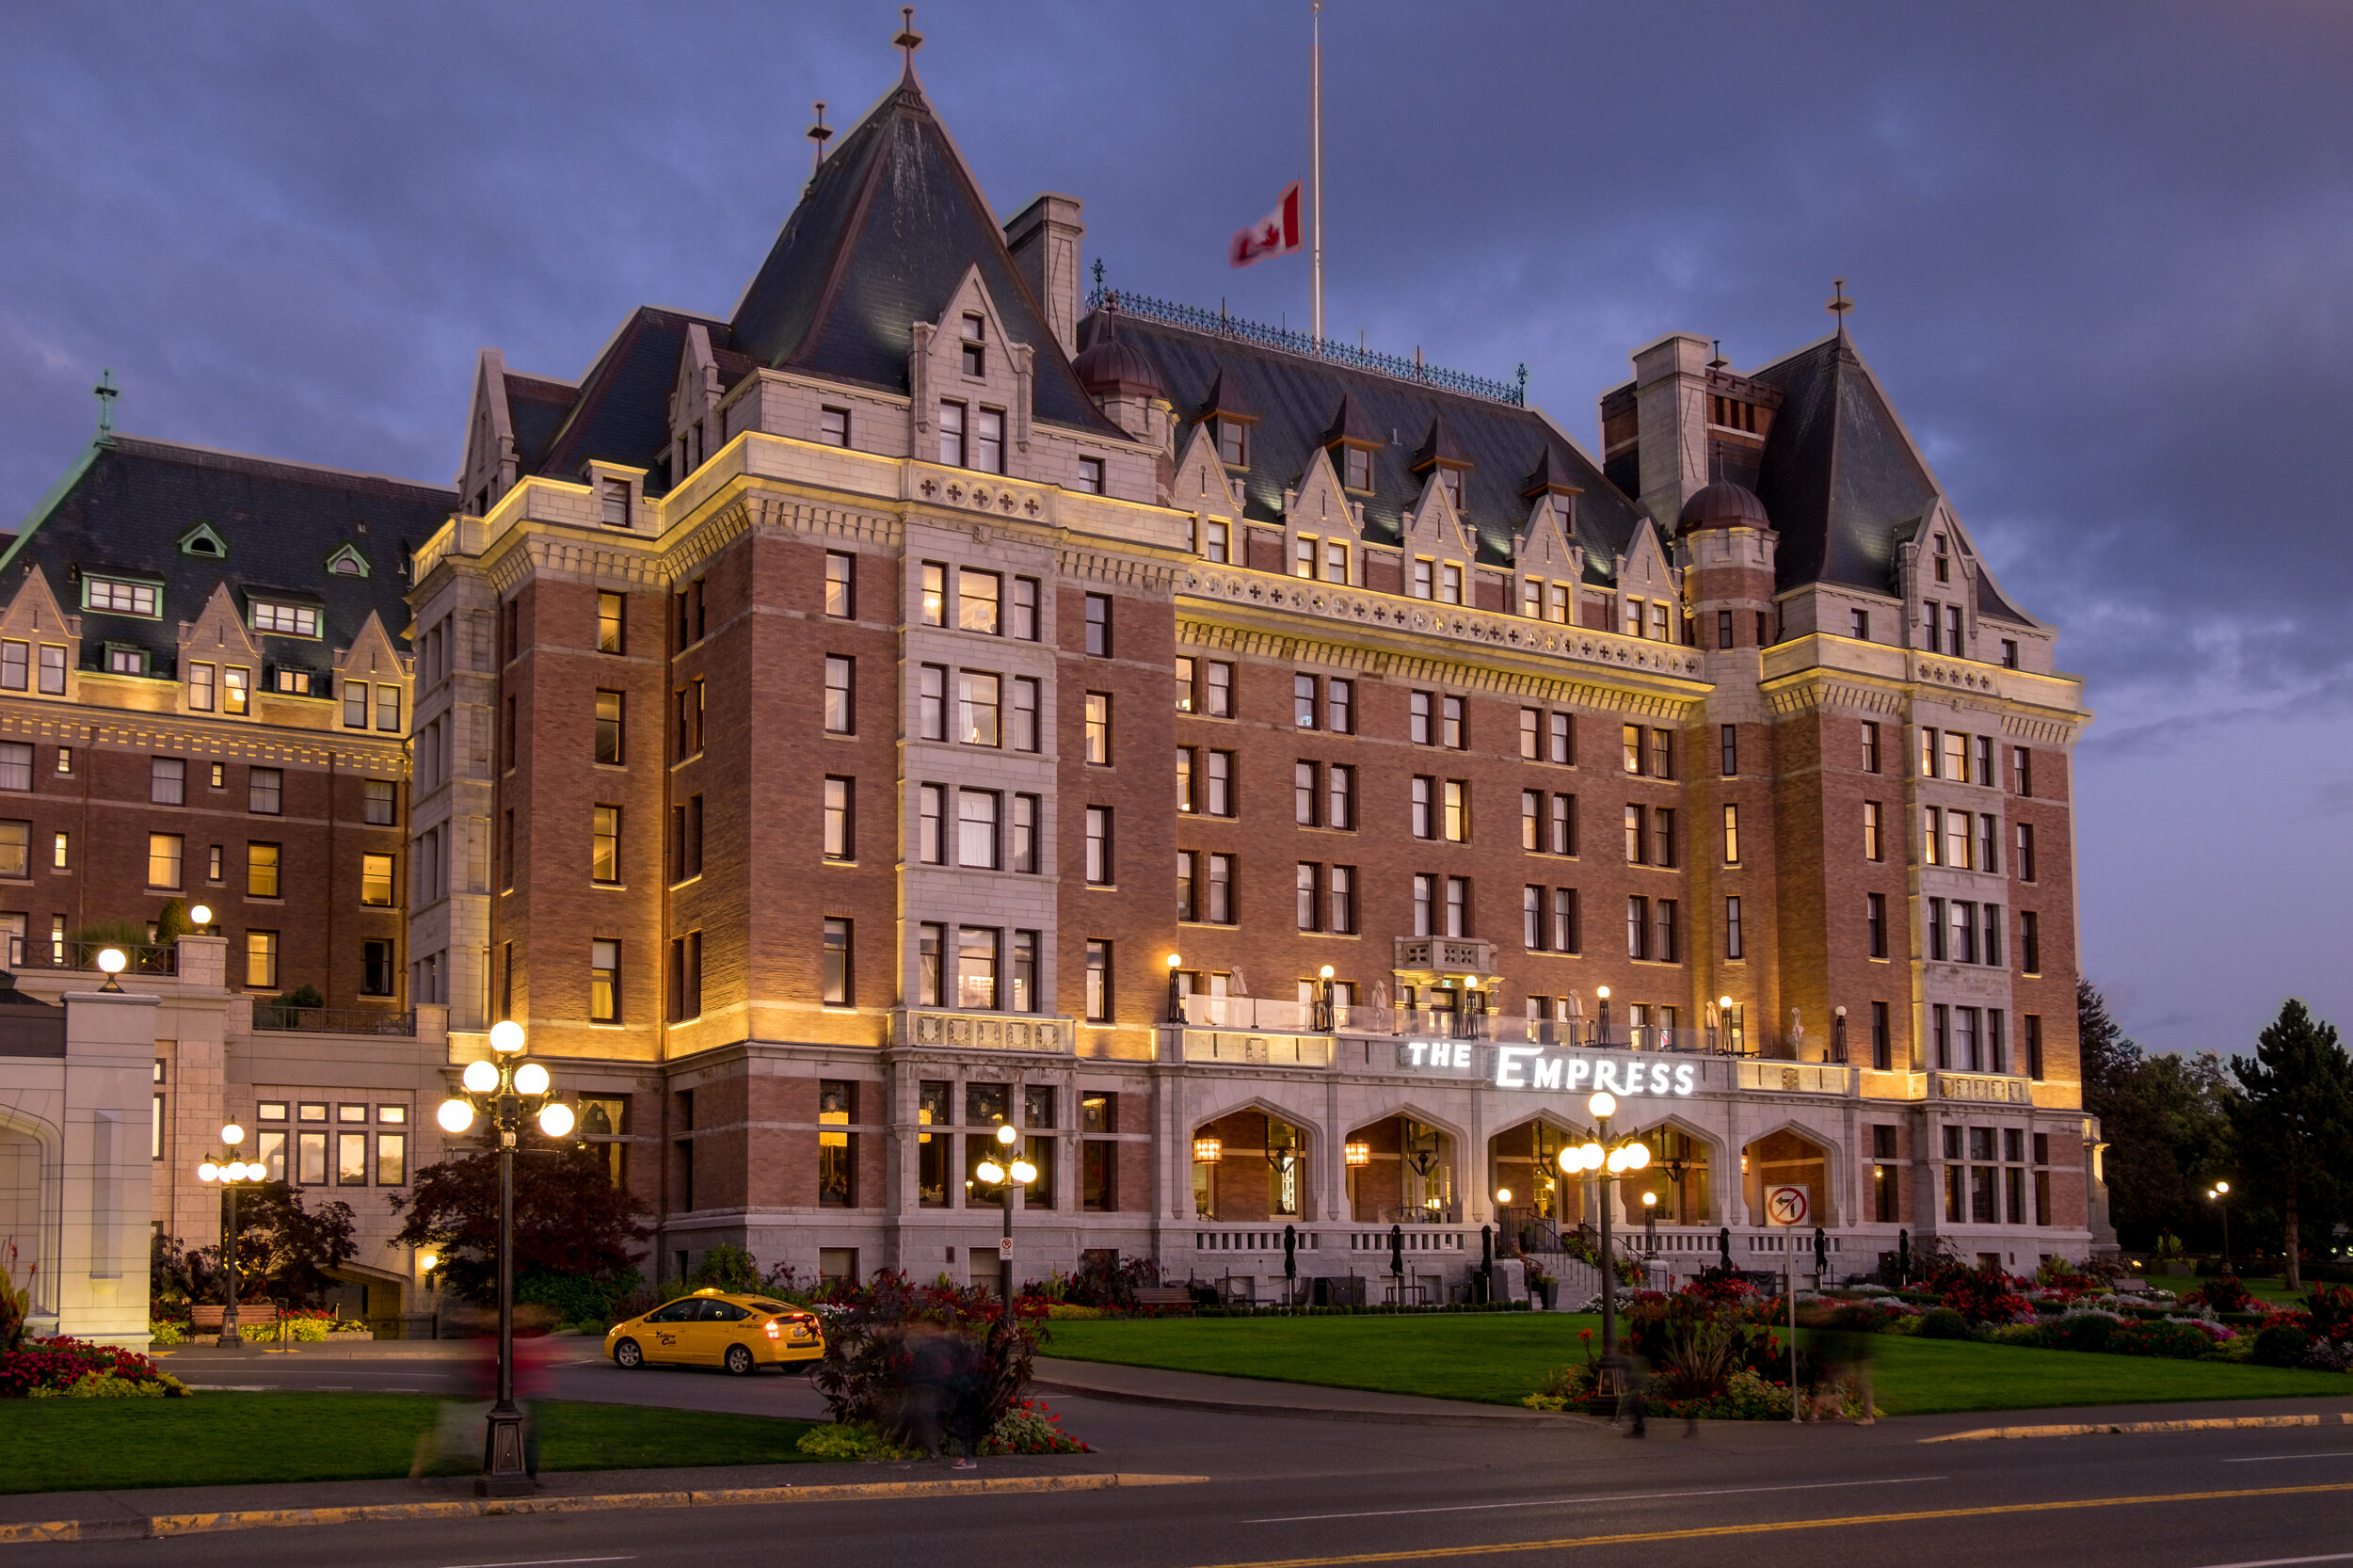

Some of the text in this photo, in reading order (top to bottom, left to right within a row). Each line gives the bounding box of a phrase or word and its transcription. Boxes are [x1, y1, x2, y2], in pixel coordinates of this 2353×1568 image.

[1408, 1043, 1694, 1096] THE EMPRESS
[662, 1337, 677, 1346] Cab
